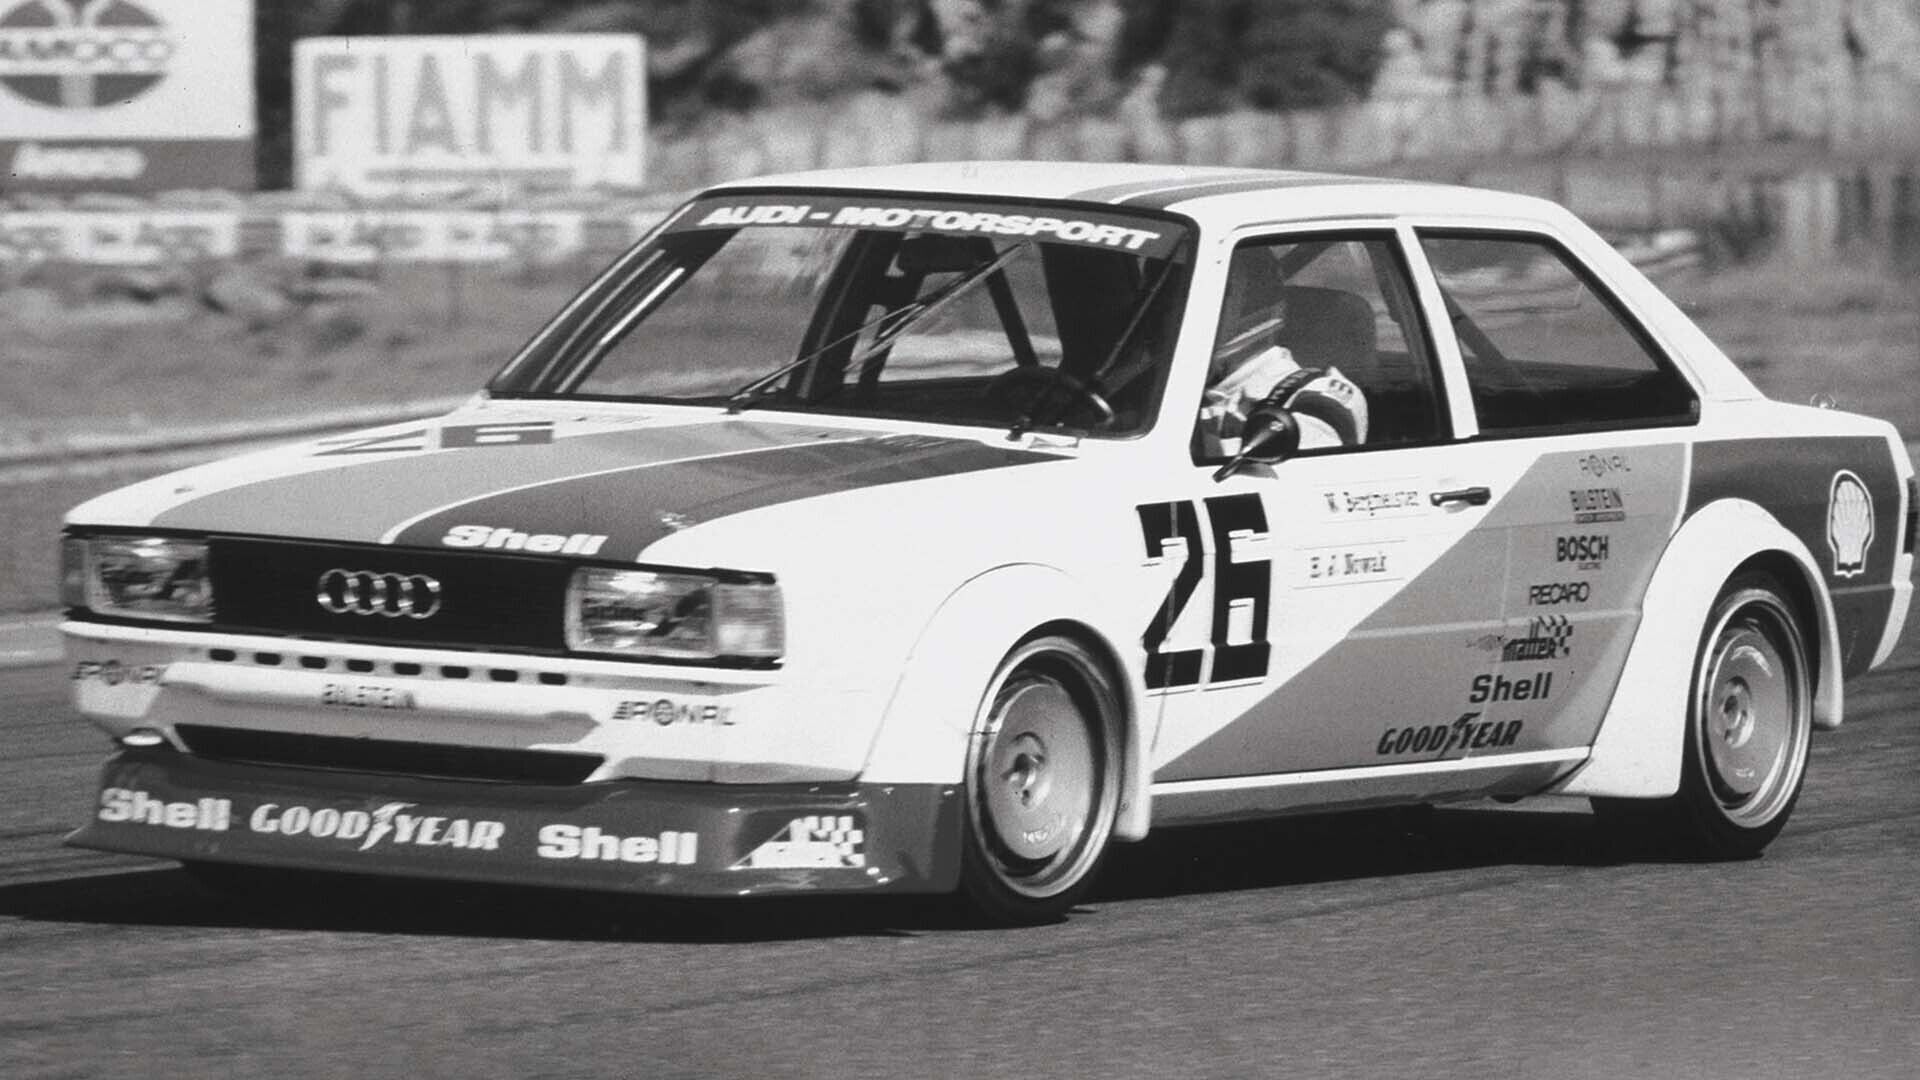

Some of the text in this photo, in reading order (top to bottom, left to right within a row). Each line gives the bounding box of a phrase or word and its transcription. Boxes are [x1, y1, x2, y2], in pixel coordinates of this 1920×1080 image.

[313, 49, 626, 155] FIAMM
[441, 524, 608, 556] Shell
[1556, 534, 1610, 563] BOSCH
[1135, 492, 1273, 692] 26
[1529, 582, 1590, 605] RECARO
[1469, 672, 1553, 703] Shell
[1376, 712, 1523, 758] GOODYEAR
[98, 787, 232, 831] Shell
[250, 801, 506, 852] GOODYEAR
[537, 823, 698, 866] Shell
